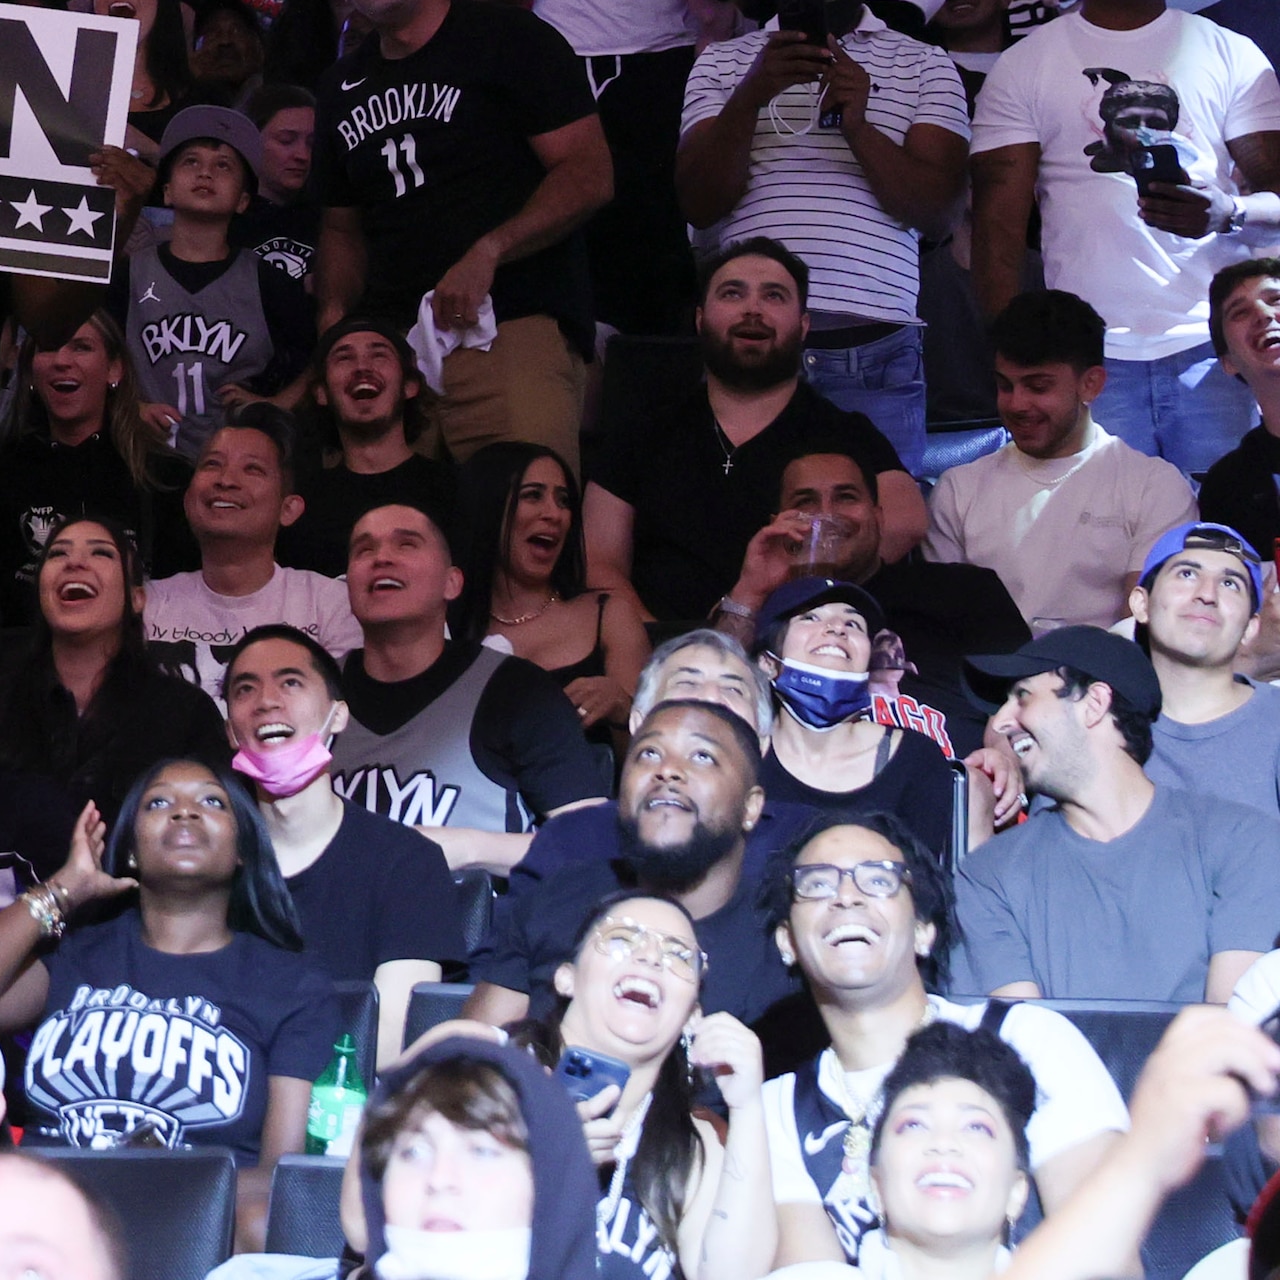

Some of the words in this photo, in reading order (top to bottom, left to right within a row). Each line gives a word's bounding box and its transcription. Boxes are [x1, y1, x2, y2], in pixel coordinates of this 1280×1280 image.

[337, 82, 461, 151] BROOKLYN
[380, 131, 425, 199] 11
[139, 312, 247, 365] BKLYN
[172, 360, 207, 418] 11
[70, 983, 223, 1028] BROOKLYN
[26, 1008, 251, 1125] PLAYOFFS
